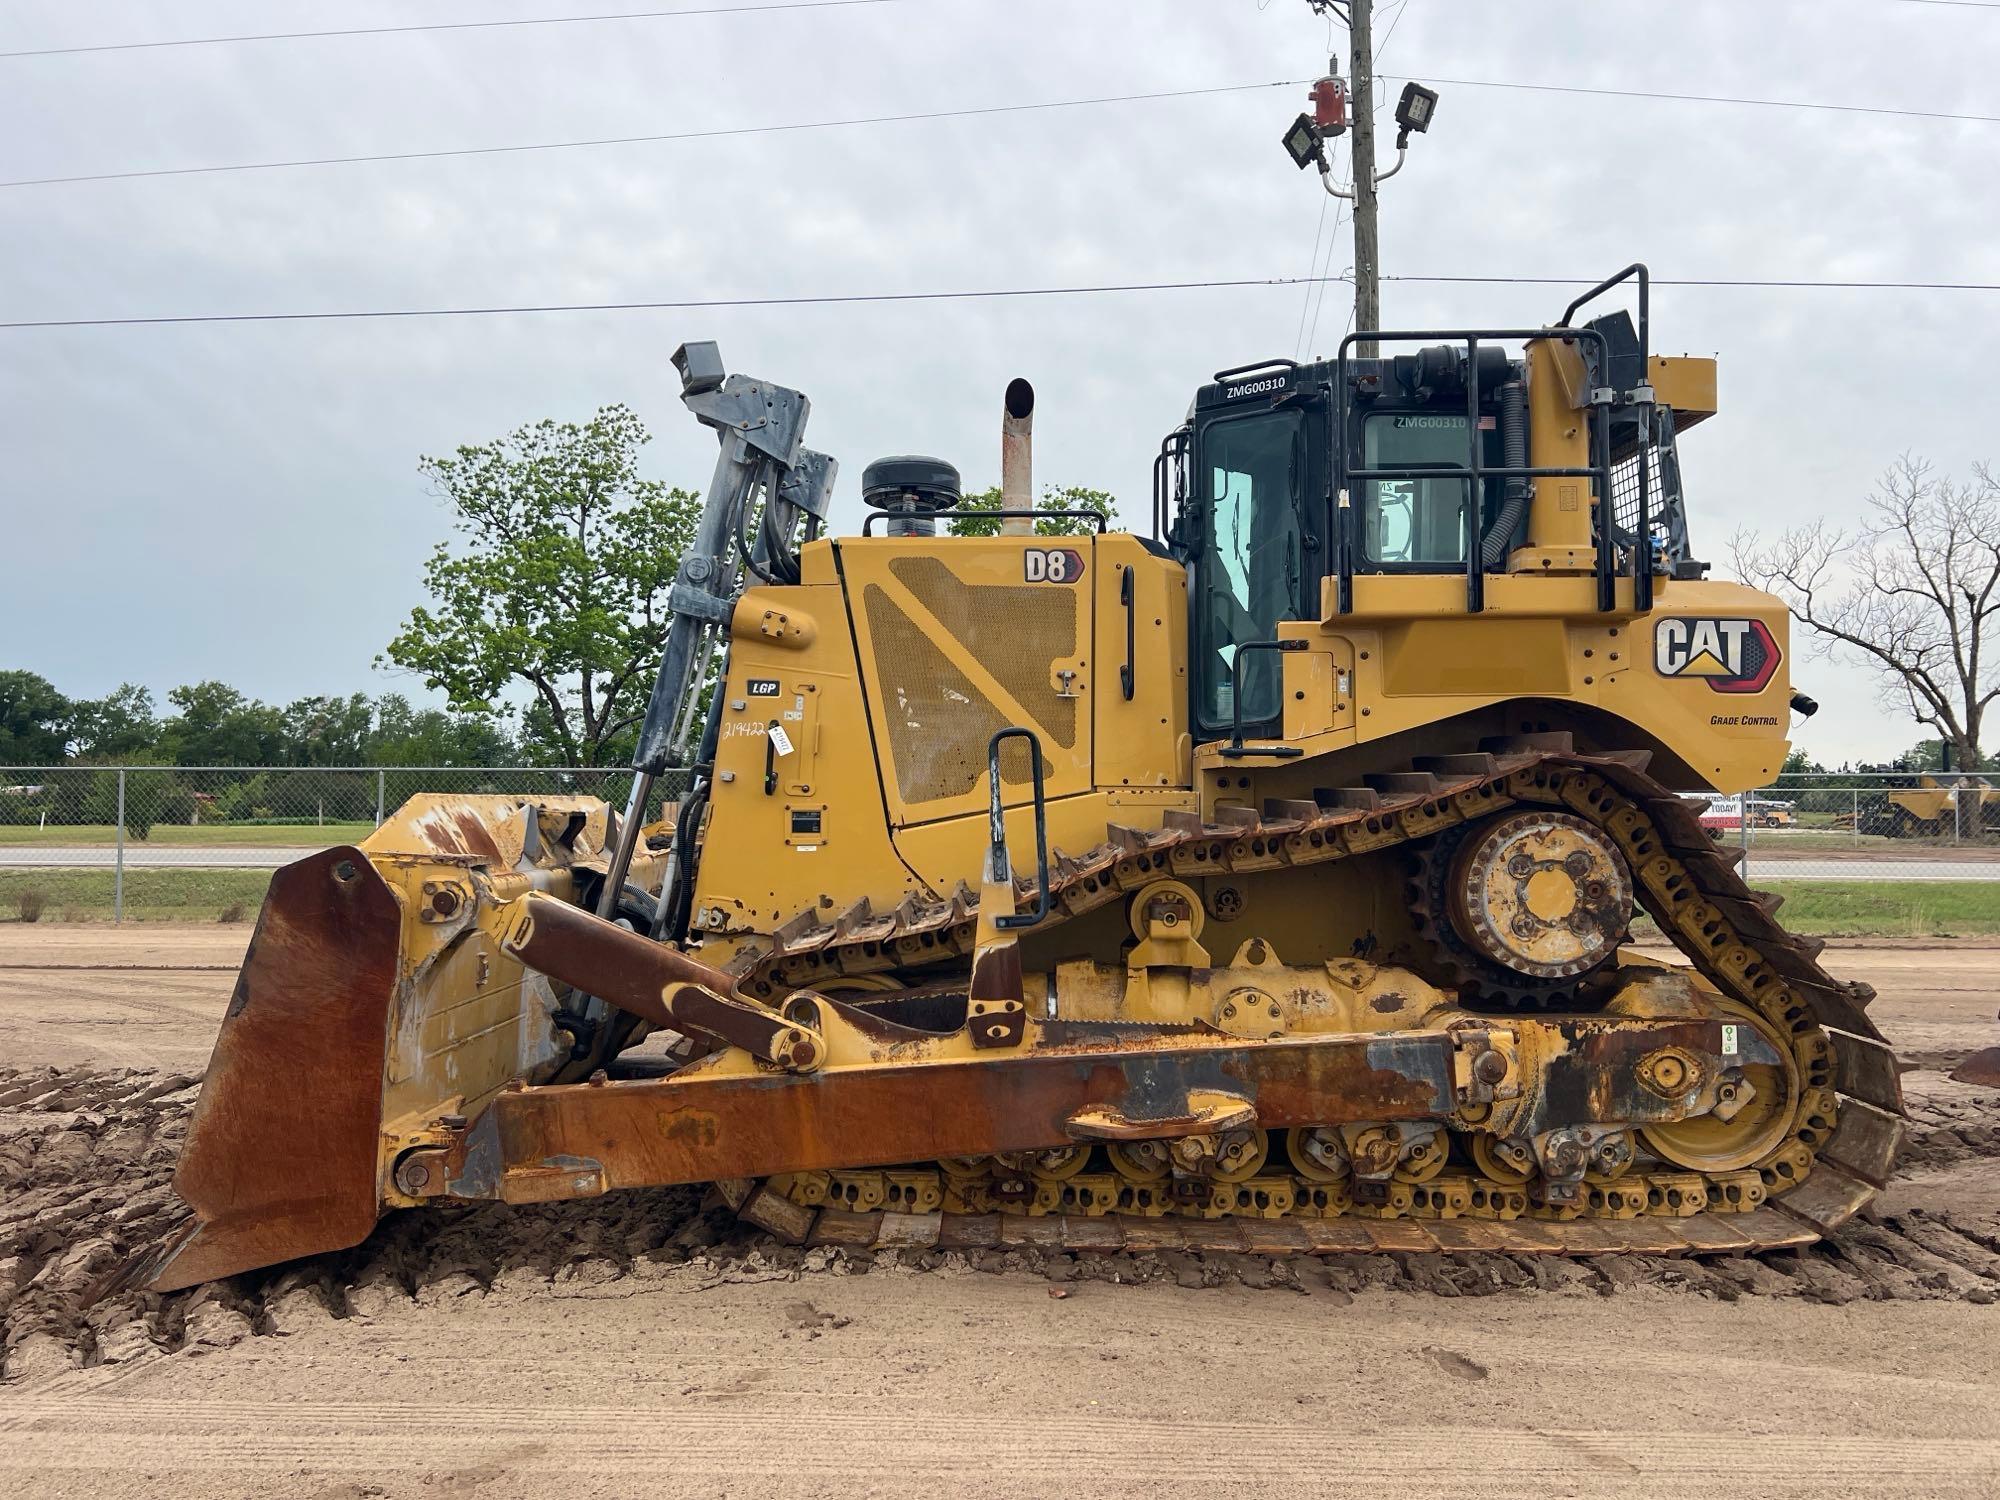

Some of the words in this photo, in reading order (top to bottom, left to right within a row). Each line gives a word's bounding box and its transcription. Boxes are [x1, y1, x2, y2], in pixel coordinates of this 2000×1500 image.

[1226, 377, 1286, 399] ZMG00310
[1397, 417, 1466, 428] ZMG00310
[1026, 551, 1066, 581] D8
[1656, 619, 1750, 675] CAT
[752, 683, 777, 694] LGP
[1710, 715, 1739, 726] GRADE
[1741, 715, 1779, 726] CONTROL
[722, 721, 767, 740] 219422
